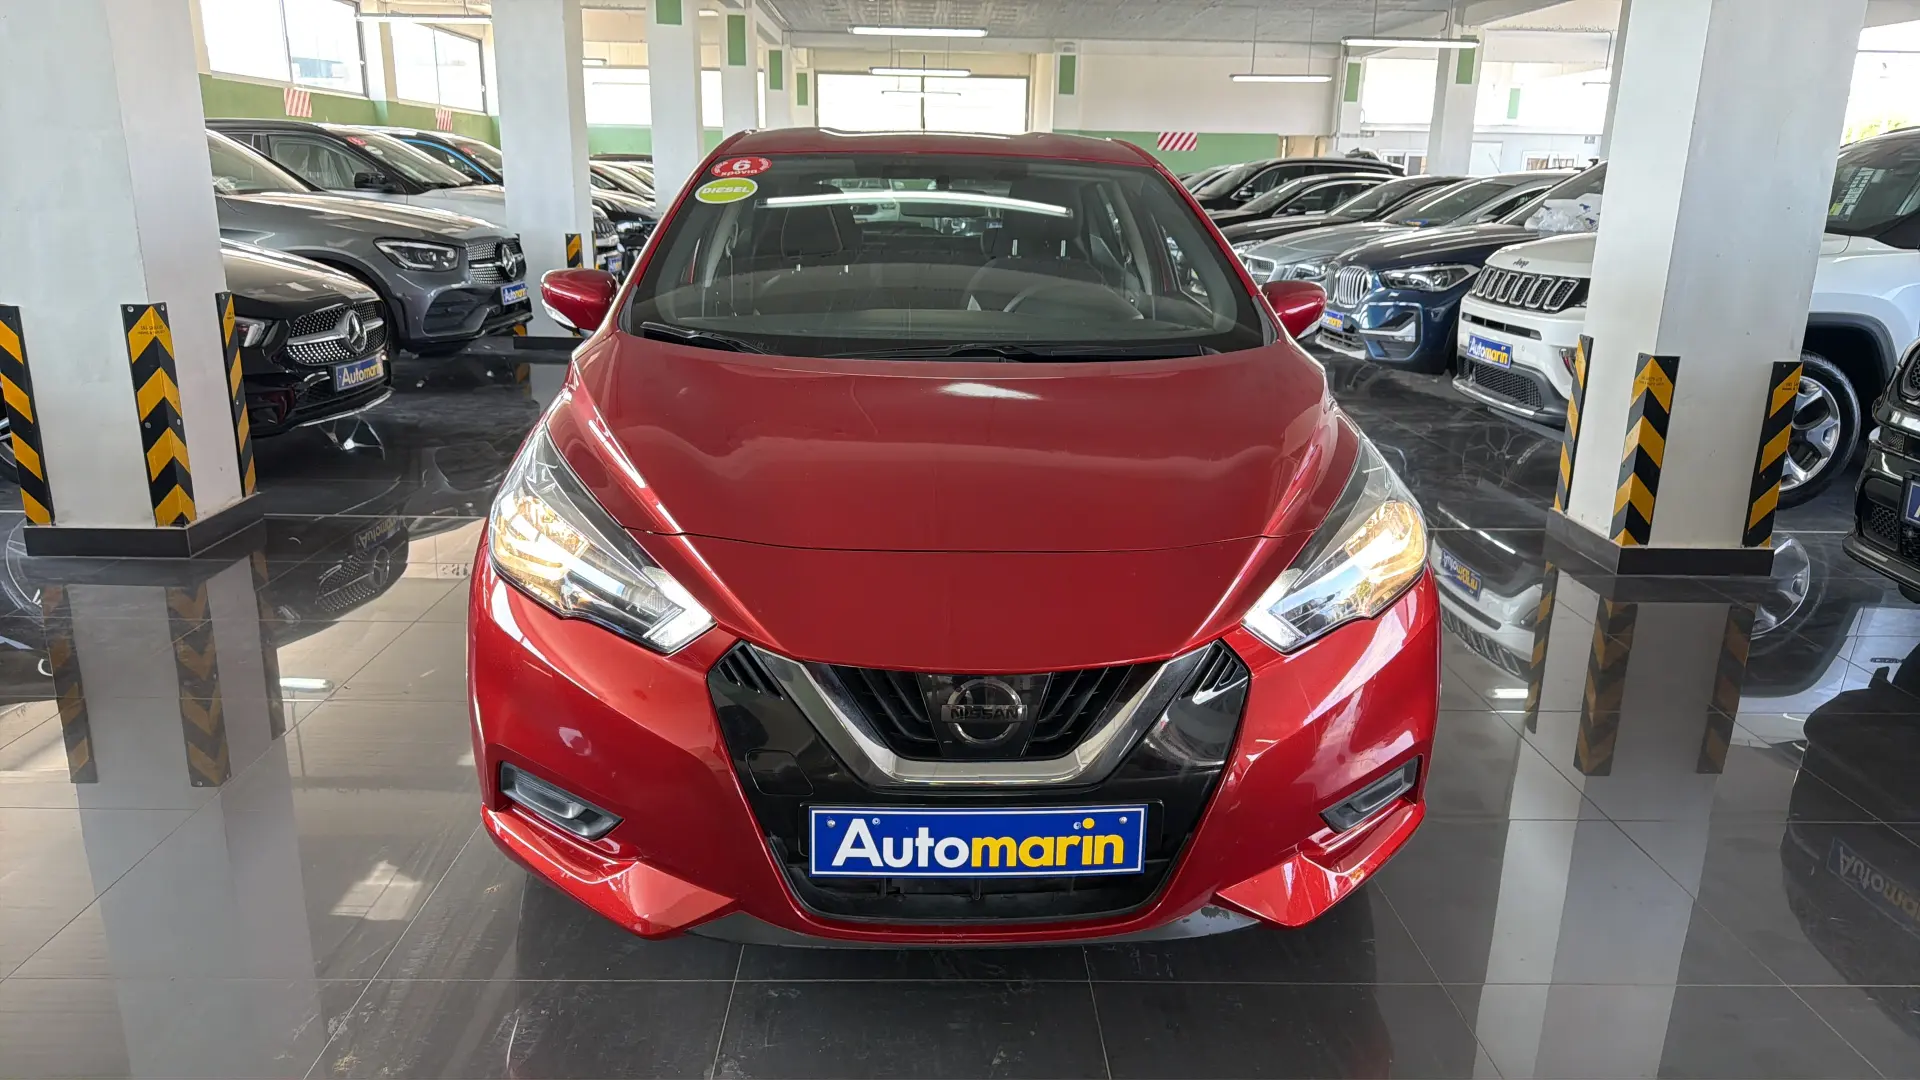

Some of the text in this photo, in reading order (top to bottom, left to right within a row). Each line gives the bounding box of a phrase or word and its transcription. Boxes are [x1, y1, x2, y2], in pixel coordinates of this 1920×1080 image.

[701, 186, 751, 195] DIESEL
[1468, 336, 1509, 365] Automarin
[949, 705, 1020, 720] NISSAN
[831, 817, 1125, 868] Automarin
